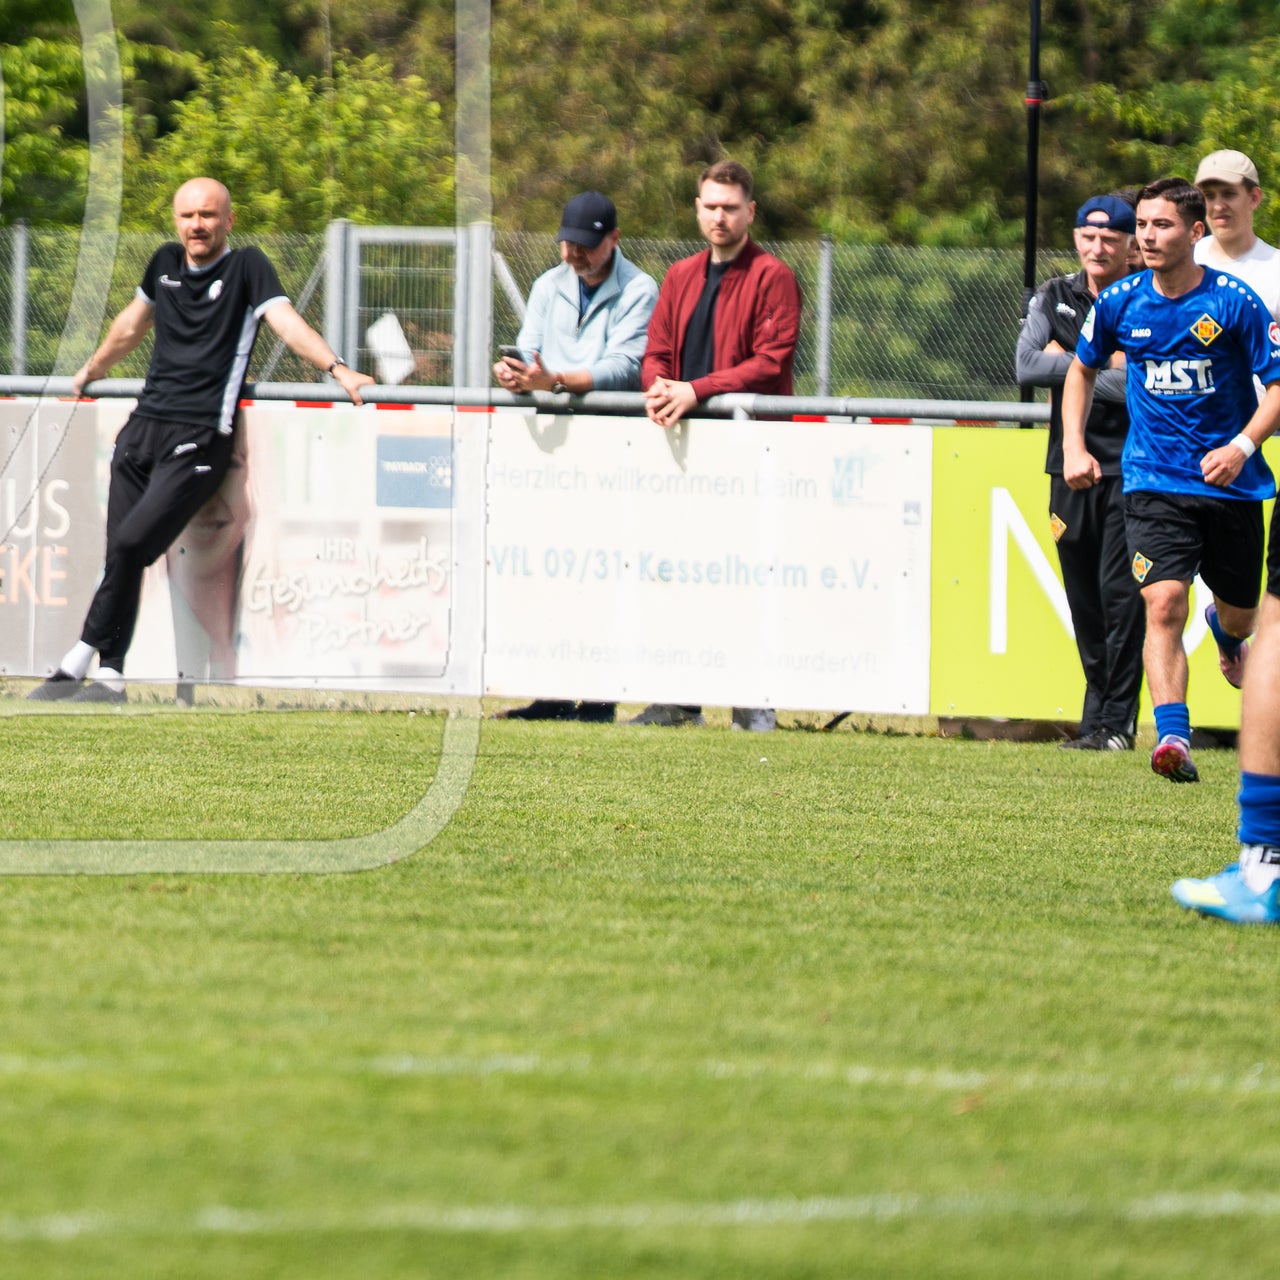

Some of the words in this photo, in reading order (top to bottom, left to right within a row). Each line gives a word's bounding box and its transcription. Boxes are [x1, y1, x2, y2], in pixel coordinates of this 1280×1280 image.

[1131, 328, 1152, 338] JAKO
[1144, 359, 1213, 390] MST
[493, 462, 588, 490] Herzlich
[597, 465, 745, 497] willkommen
[490, 544, 534, 577] VfL
[544, 547, 623, 583] 09/31
[639, 550, 809, 588] Kesselheim
[820, 558, 880, 591] e.V.
